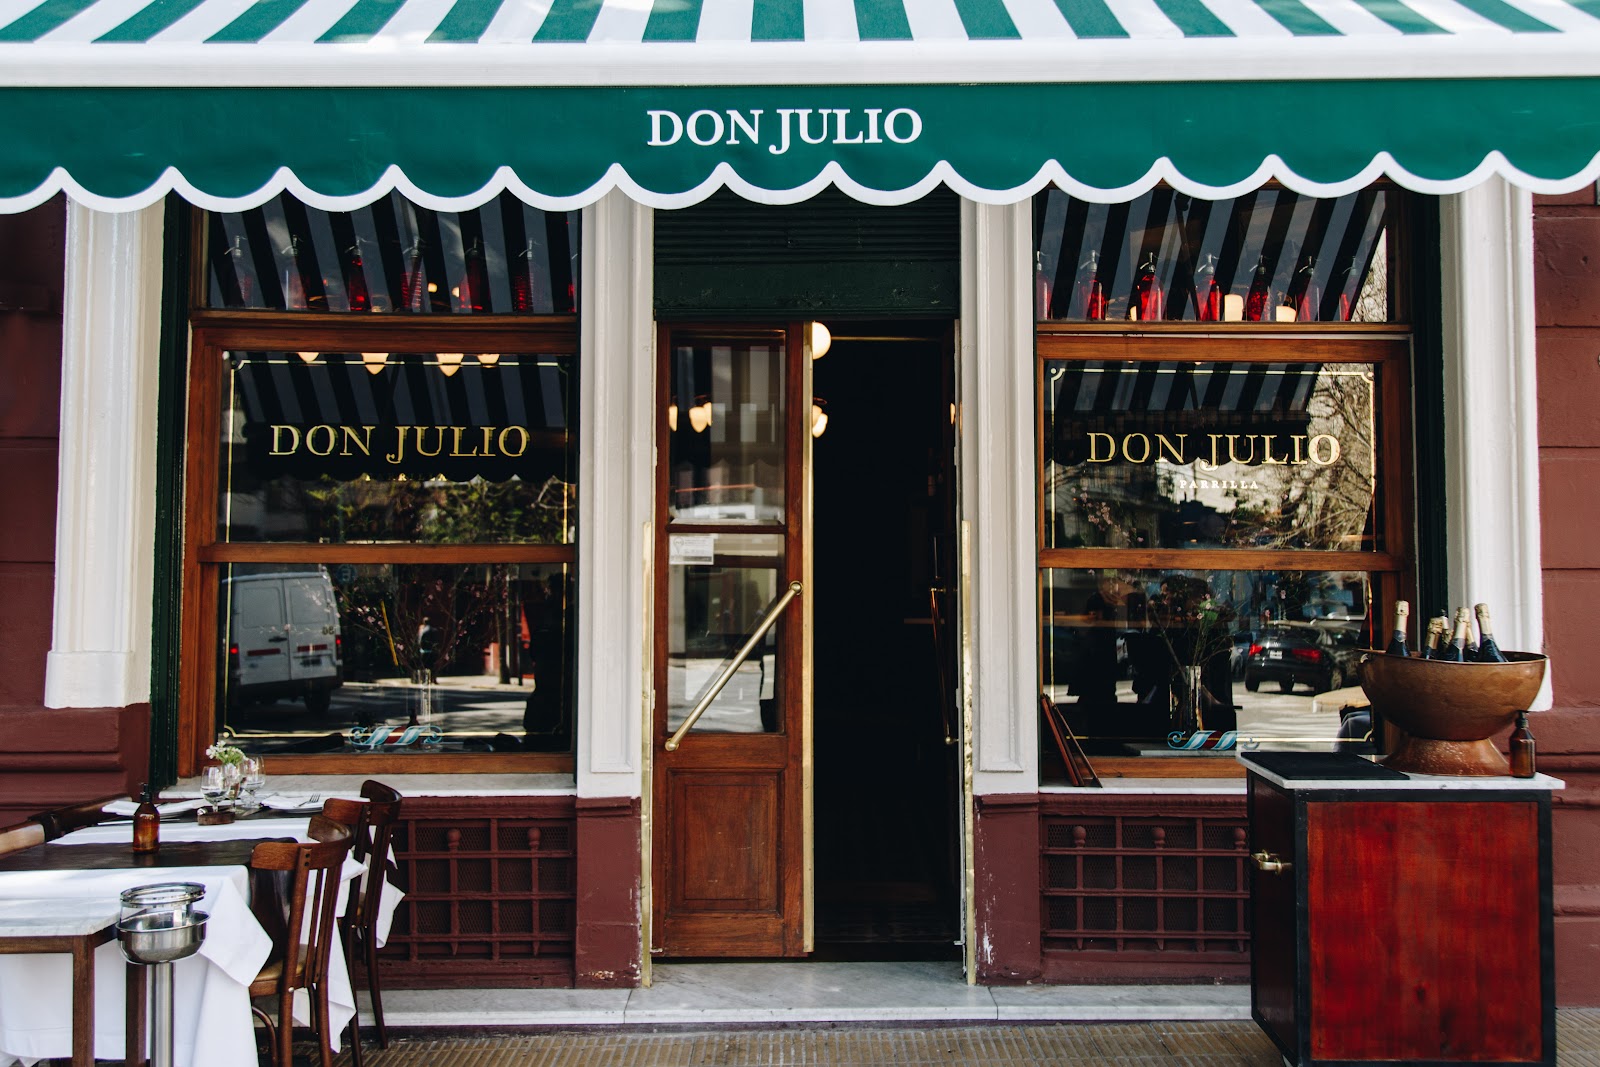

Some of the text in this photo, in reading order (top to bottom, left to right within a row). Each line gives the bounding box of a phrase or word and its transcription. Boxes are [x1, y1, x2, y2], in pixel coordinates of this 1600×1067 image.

[647, 108, 923, 155] DON JULIO
[269, 425, 530, 464] DON JULIO
[1086, 432, 1341, 471] DON JULIO
[1180, 480, 1259, 489] PARRILLA
